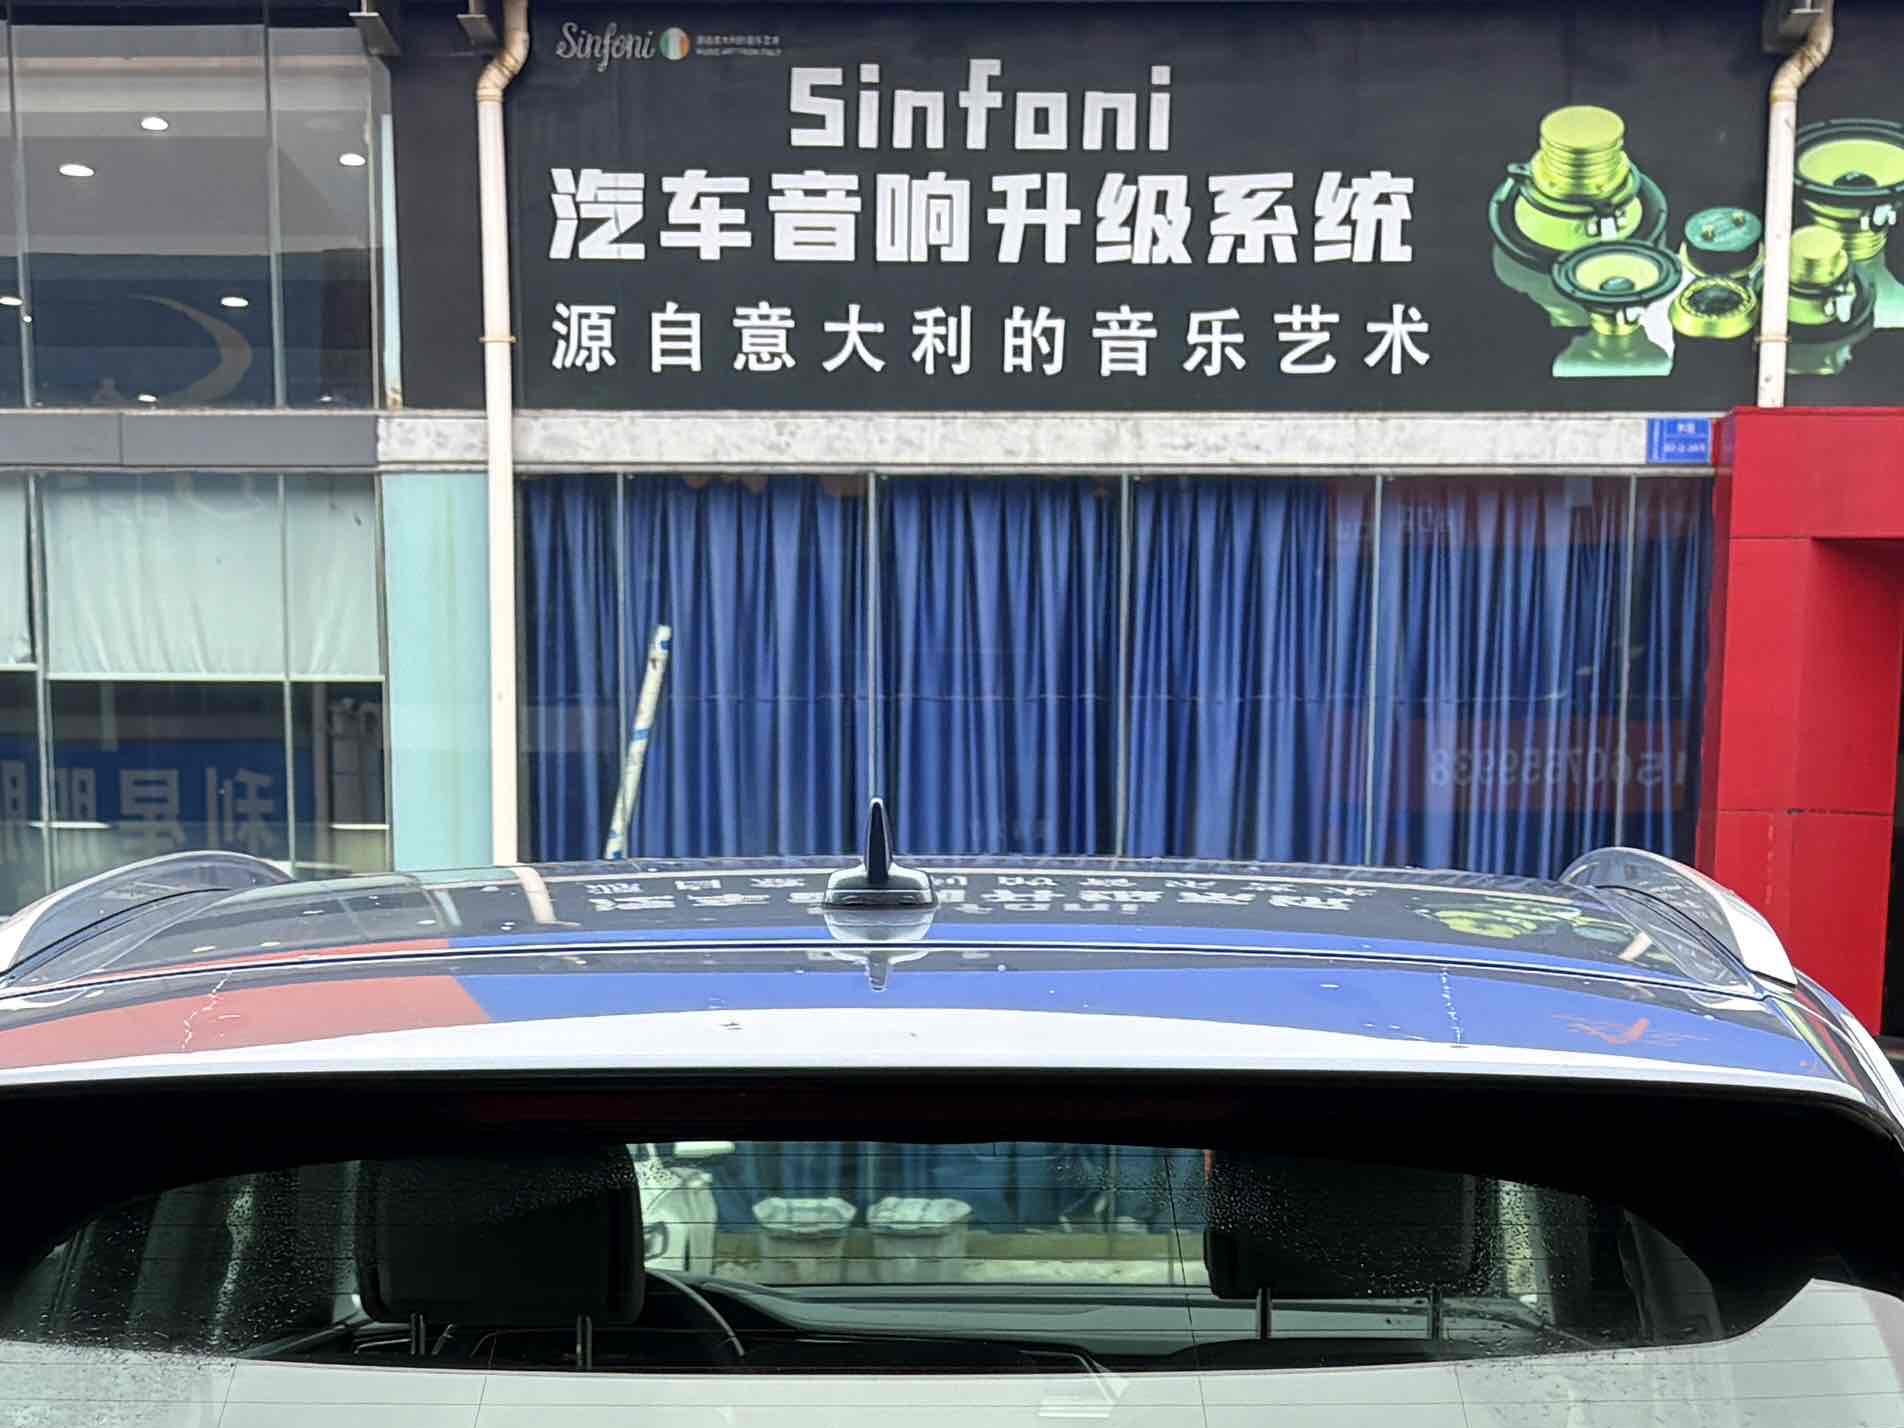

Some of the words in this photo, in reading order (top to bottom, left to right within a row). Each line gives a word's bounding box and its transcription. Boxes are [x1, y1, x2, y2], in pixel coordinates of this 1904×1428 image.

[556, 22, 654, 72] Sinfoni
[790, 58, 1171, 151] Sinfoni
[548, 167, 1414, 264] 汽车音响升级系统
[551, 301, 1431, 376] 源自意大利的音乐艺术
